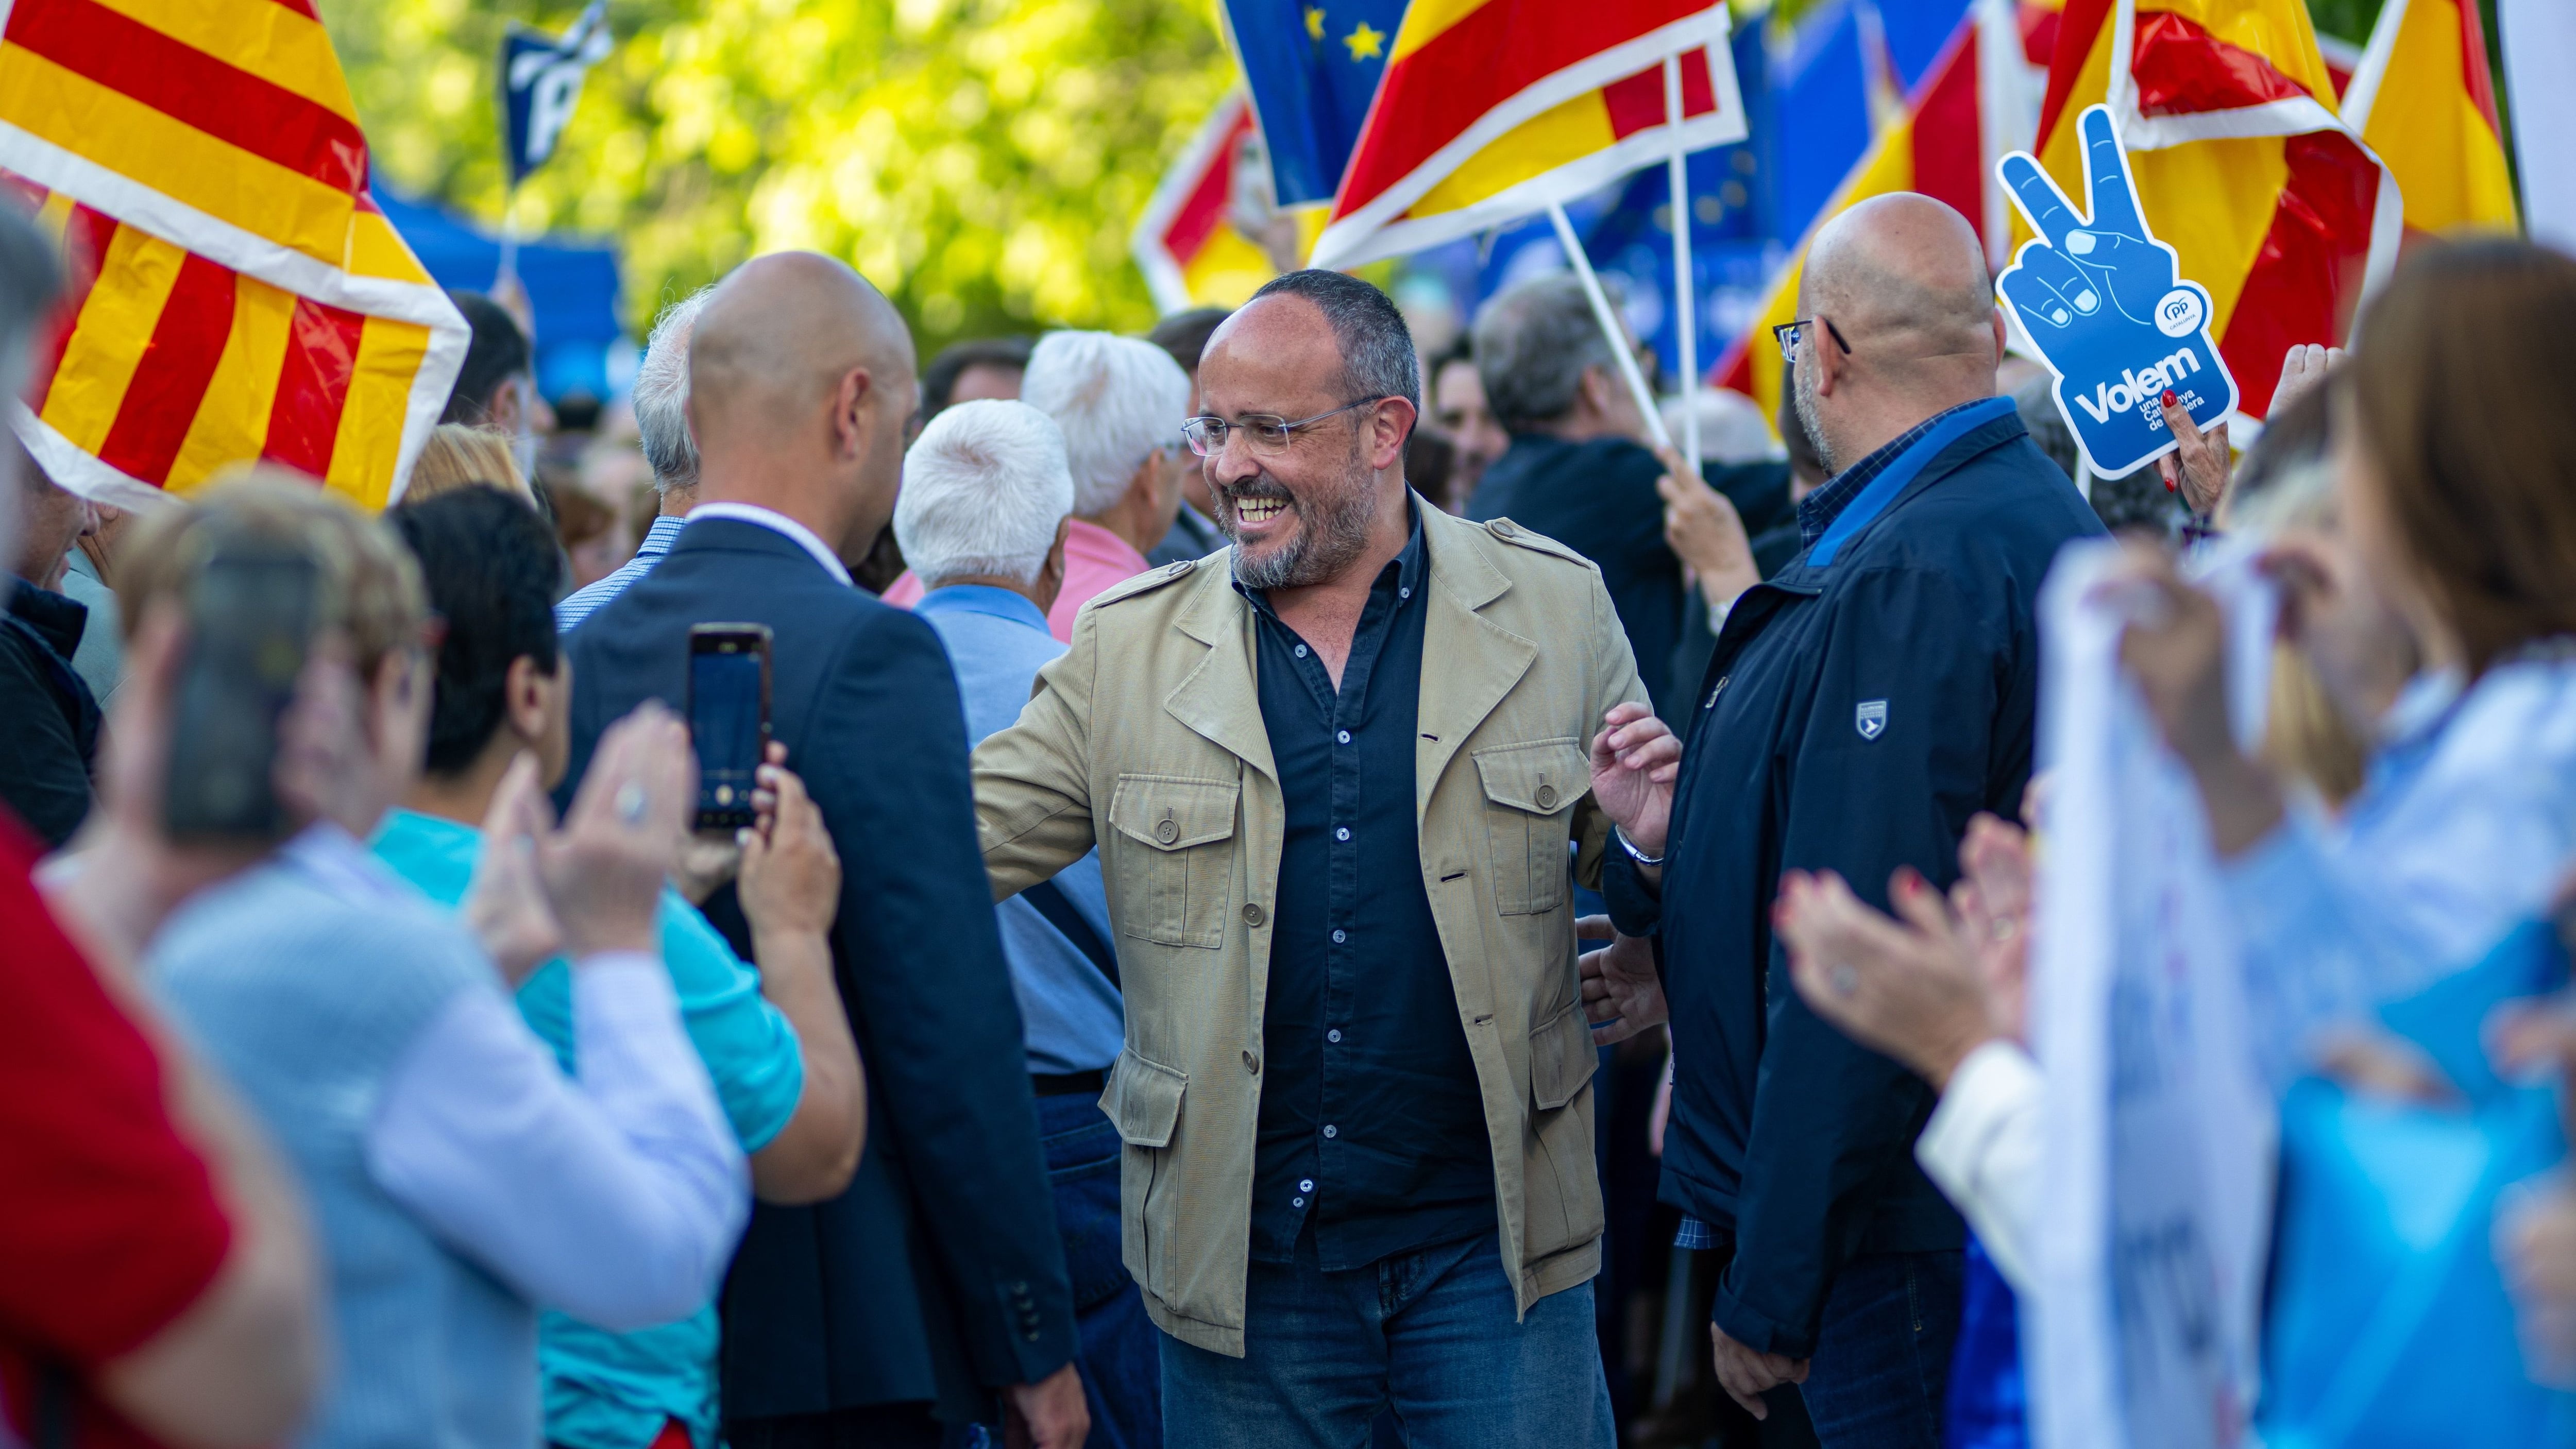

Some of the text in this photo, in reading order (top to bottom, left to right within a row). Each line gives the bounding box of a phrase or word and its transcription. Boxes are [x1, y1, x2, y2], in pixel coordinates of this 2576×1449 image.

[2170, 314, 2196, 330] CATALUNYA
[2074, 347, 2201, 424] Volem
[2139, 397, 2160, 413] una
[2143, 389, 2195, 422] Catnya
[2149, 418, 2164, 431] de
